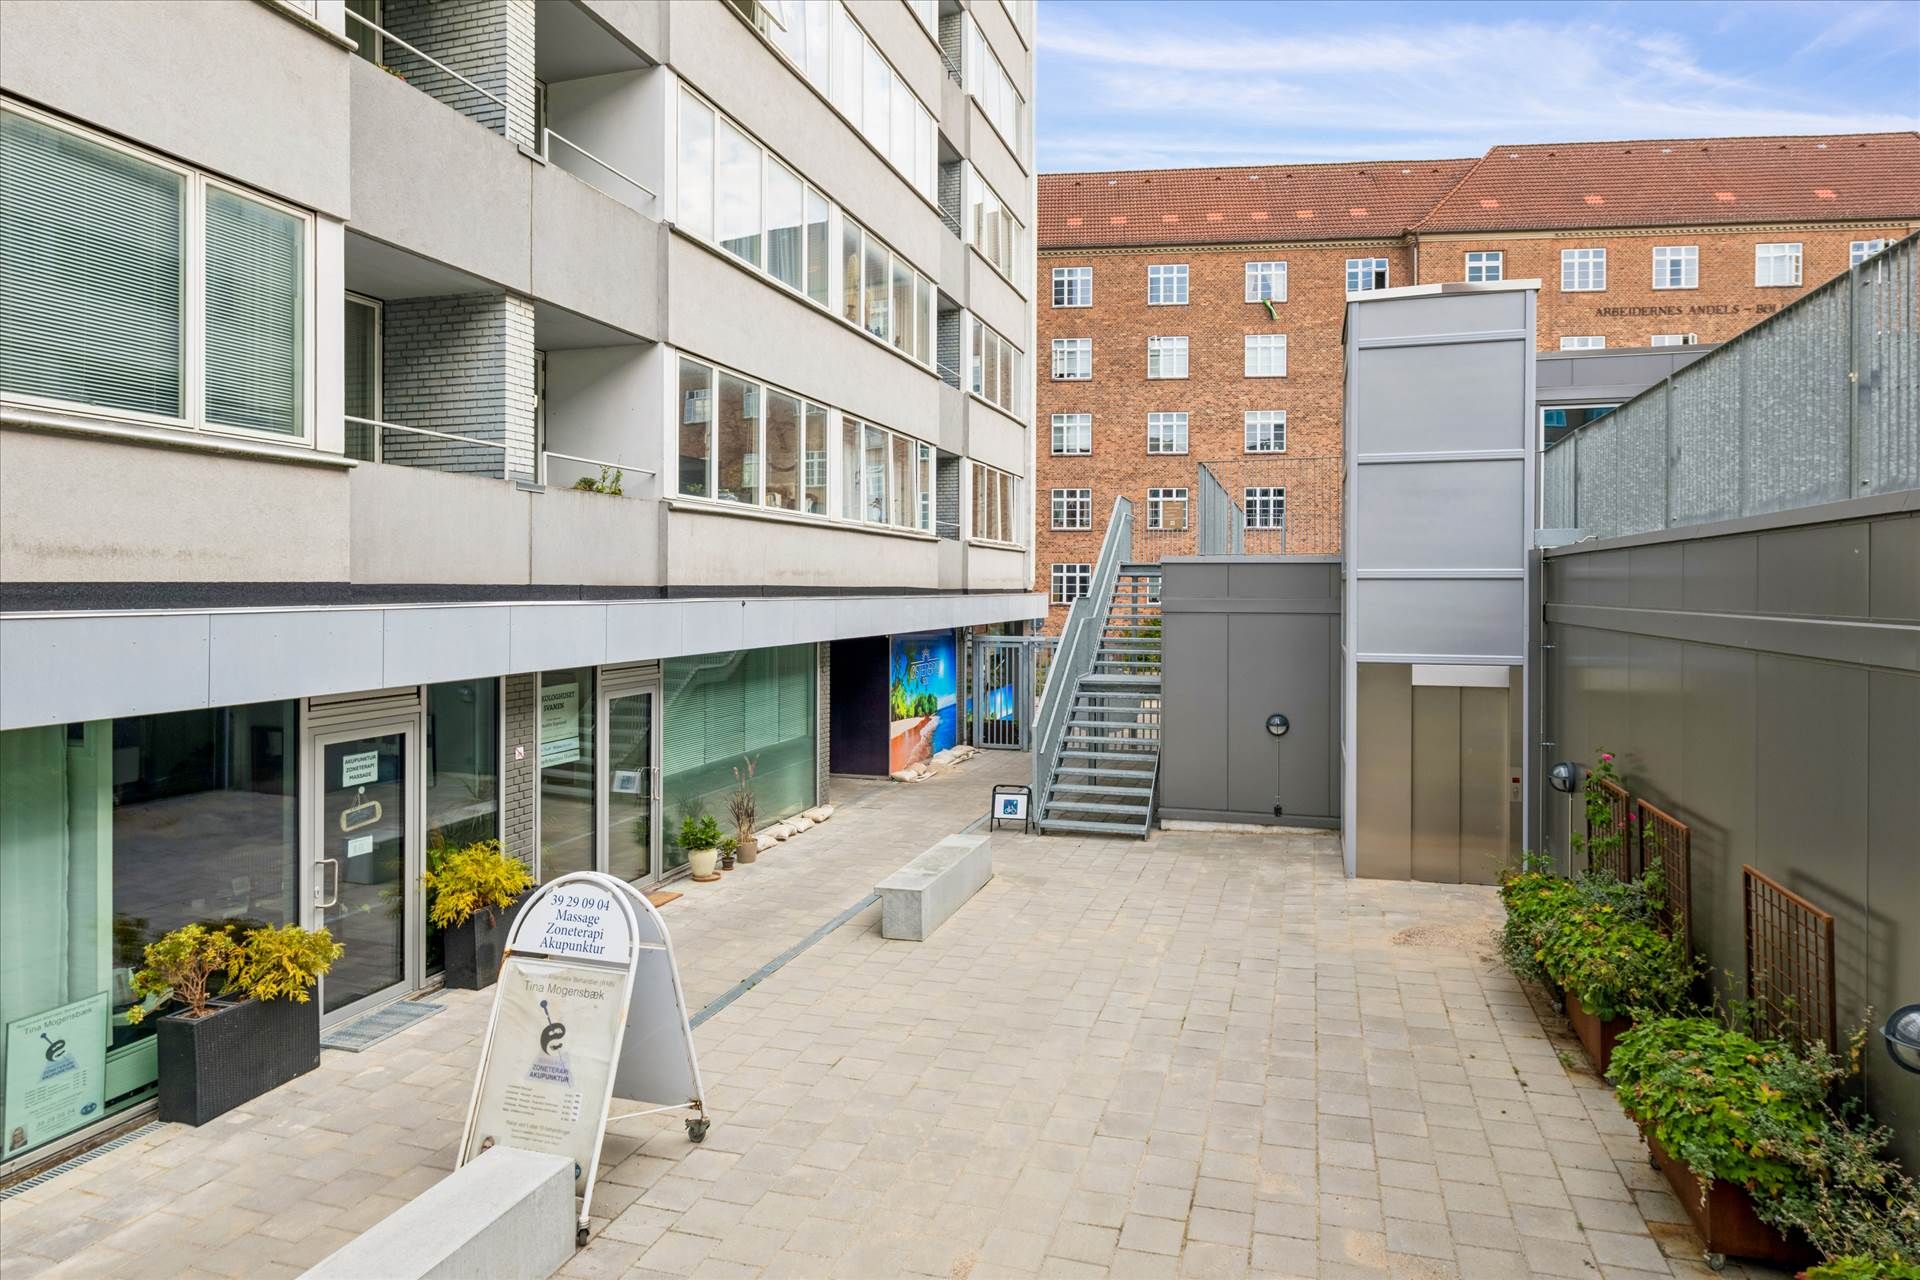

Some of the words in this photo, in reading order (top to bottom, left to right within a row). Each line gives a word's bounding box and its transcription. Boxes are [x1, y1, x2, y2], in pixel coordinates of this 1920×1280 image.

[1688, 303, 1740, 315] ANDELS
[344, 754, 377, 765] AKUPUNKTUR
[345, 762, 375, 773] ZONETERAPI
[349, 771, 372, 780] MASSAGE
[550, 894, 565, 906] 39
[566, 896, 579, 908] 29
[581, 897, 595, 910] 09
[597, 899, 610, 912] 04
[555, 909, 600, 928] Massage
[546, 922, 604, 943] Zoneterapi
[539, 936, 606, 955] Akupunktur
[523, 980, 545, 993] Tina
[547, 983, 605, 1001] Mogensbæk
[532, 1063, 569, 1076] ZONETERAPI
[529, 1071, 570, 1083] AKUPUNKTUR
